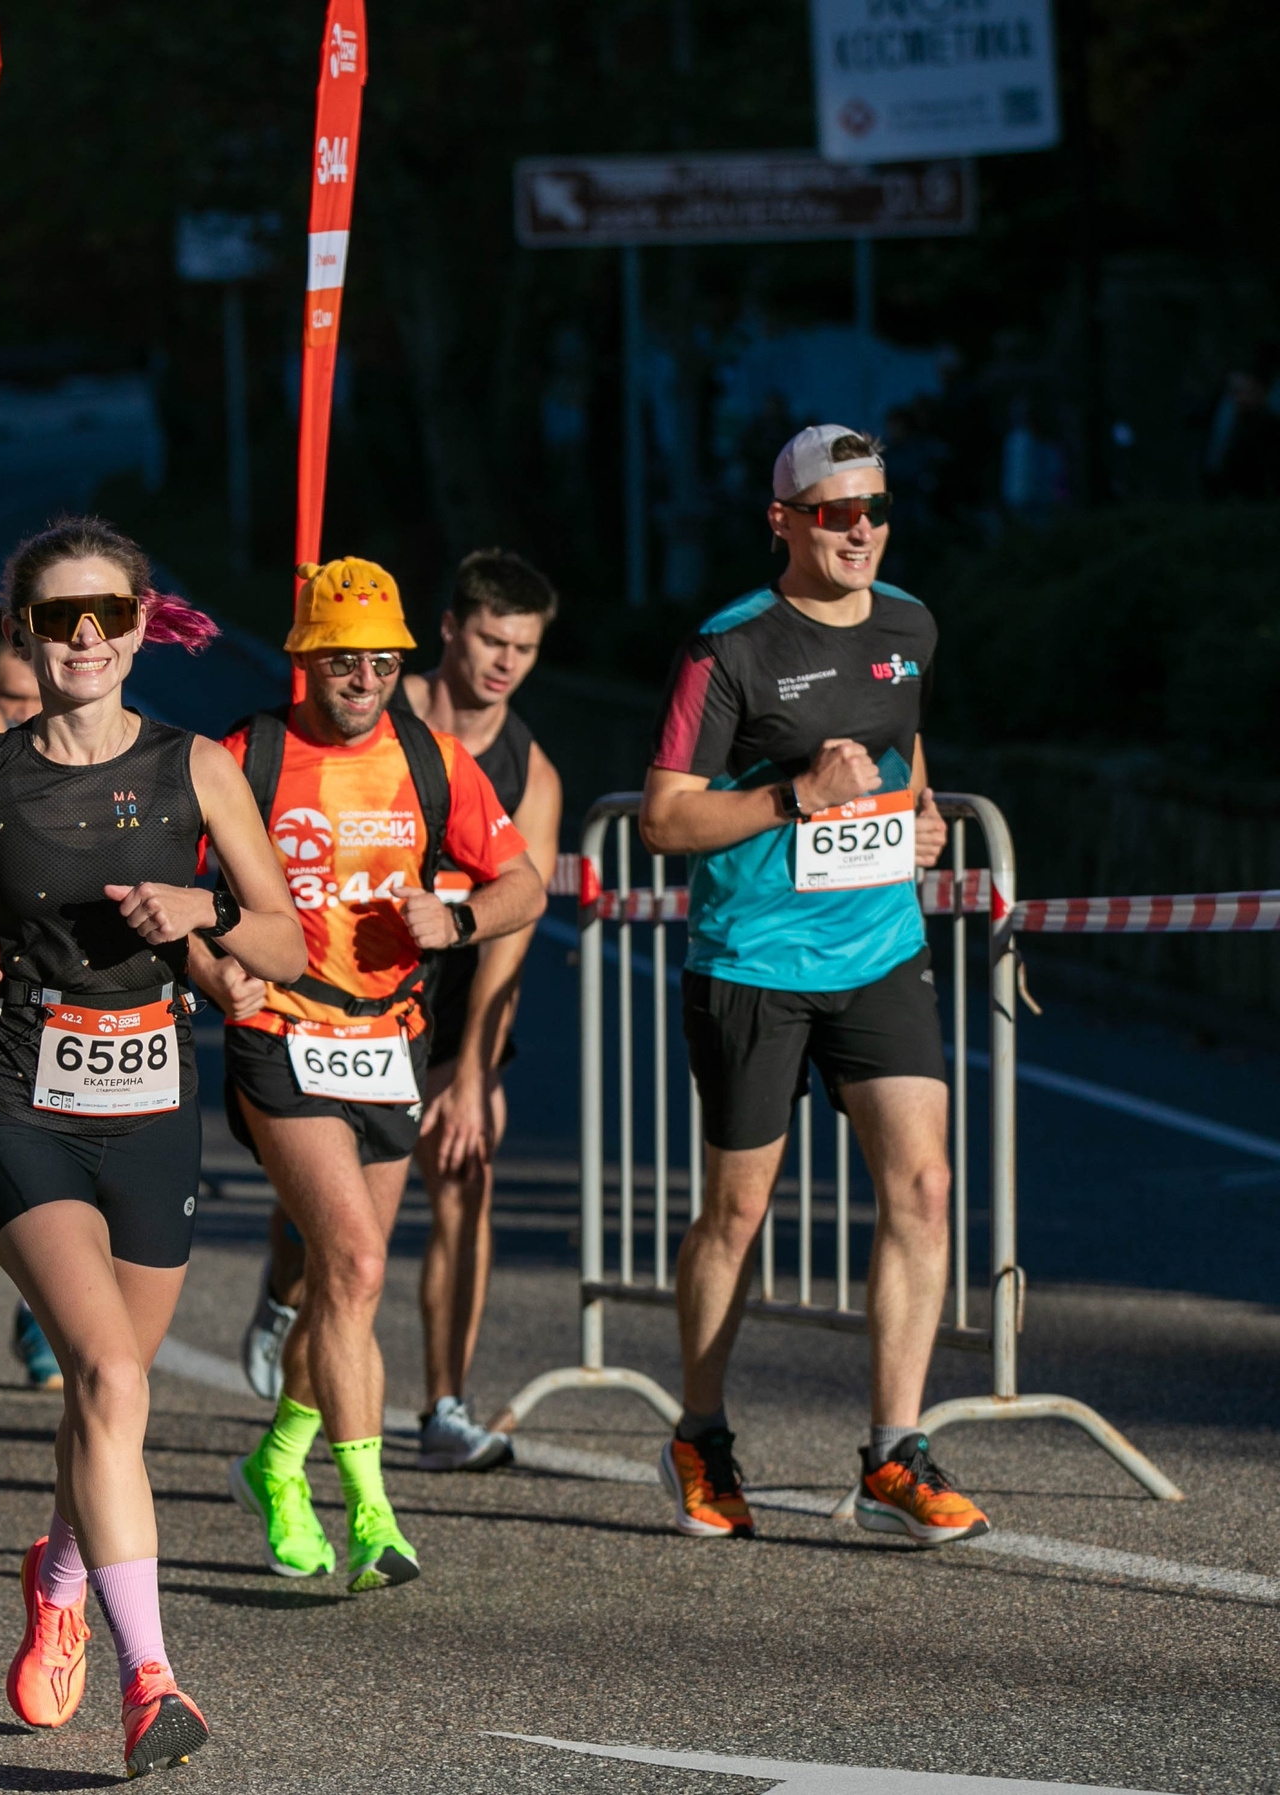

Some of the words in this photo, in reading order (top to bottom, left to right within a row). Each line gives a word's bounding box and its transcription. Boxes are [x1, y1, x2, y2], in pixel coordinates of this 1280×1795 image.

[317, 136, 349, 185] 3:44
[338, 810, 414, 819] СОВКОМБАНК
[338, 820, 416, 837] СОЧИ
[812, 818, 903, 855] 6520
[339, 837, 416, 847] МАРАФОН
[287, 866, 331, 876] МАРАФОН
[290, 870, 405, 910] 3:44
[61, 1012, 82, 1024] 42.2
[56, 1033, 168, 1075] 6588
[305, 1048, 393, 1077] 6667
[83, 1077, 144, 1087] ЕКАТЕРИНА
